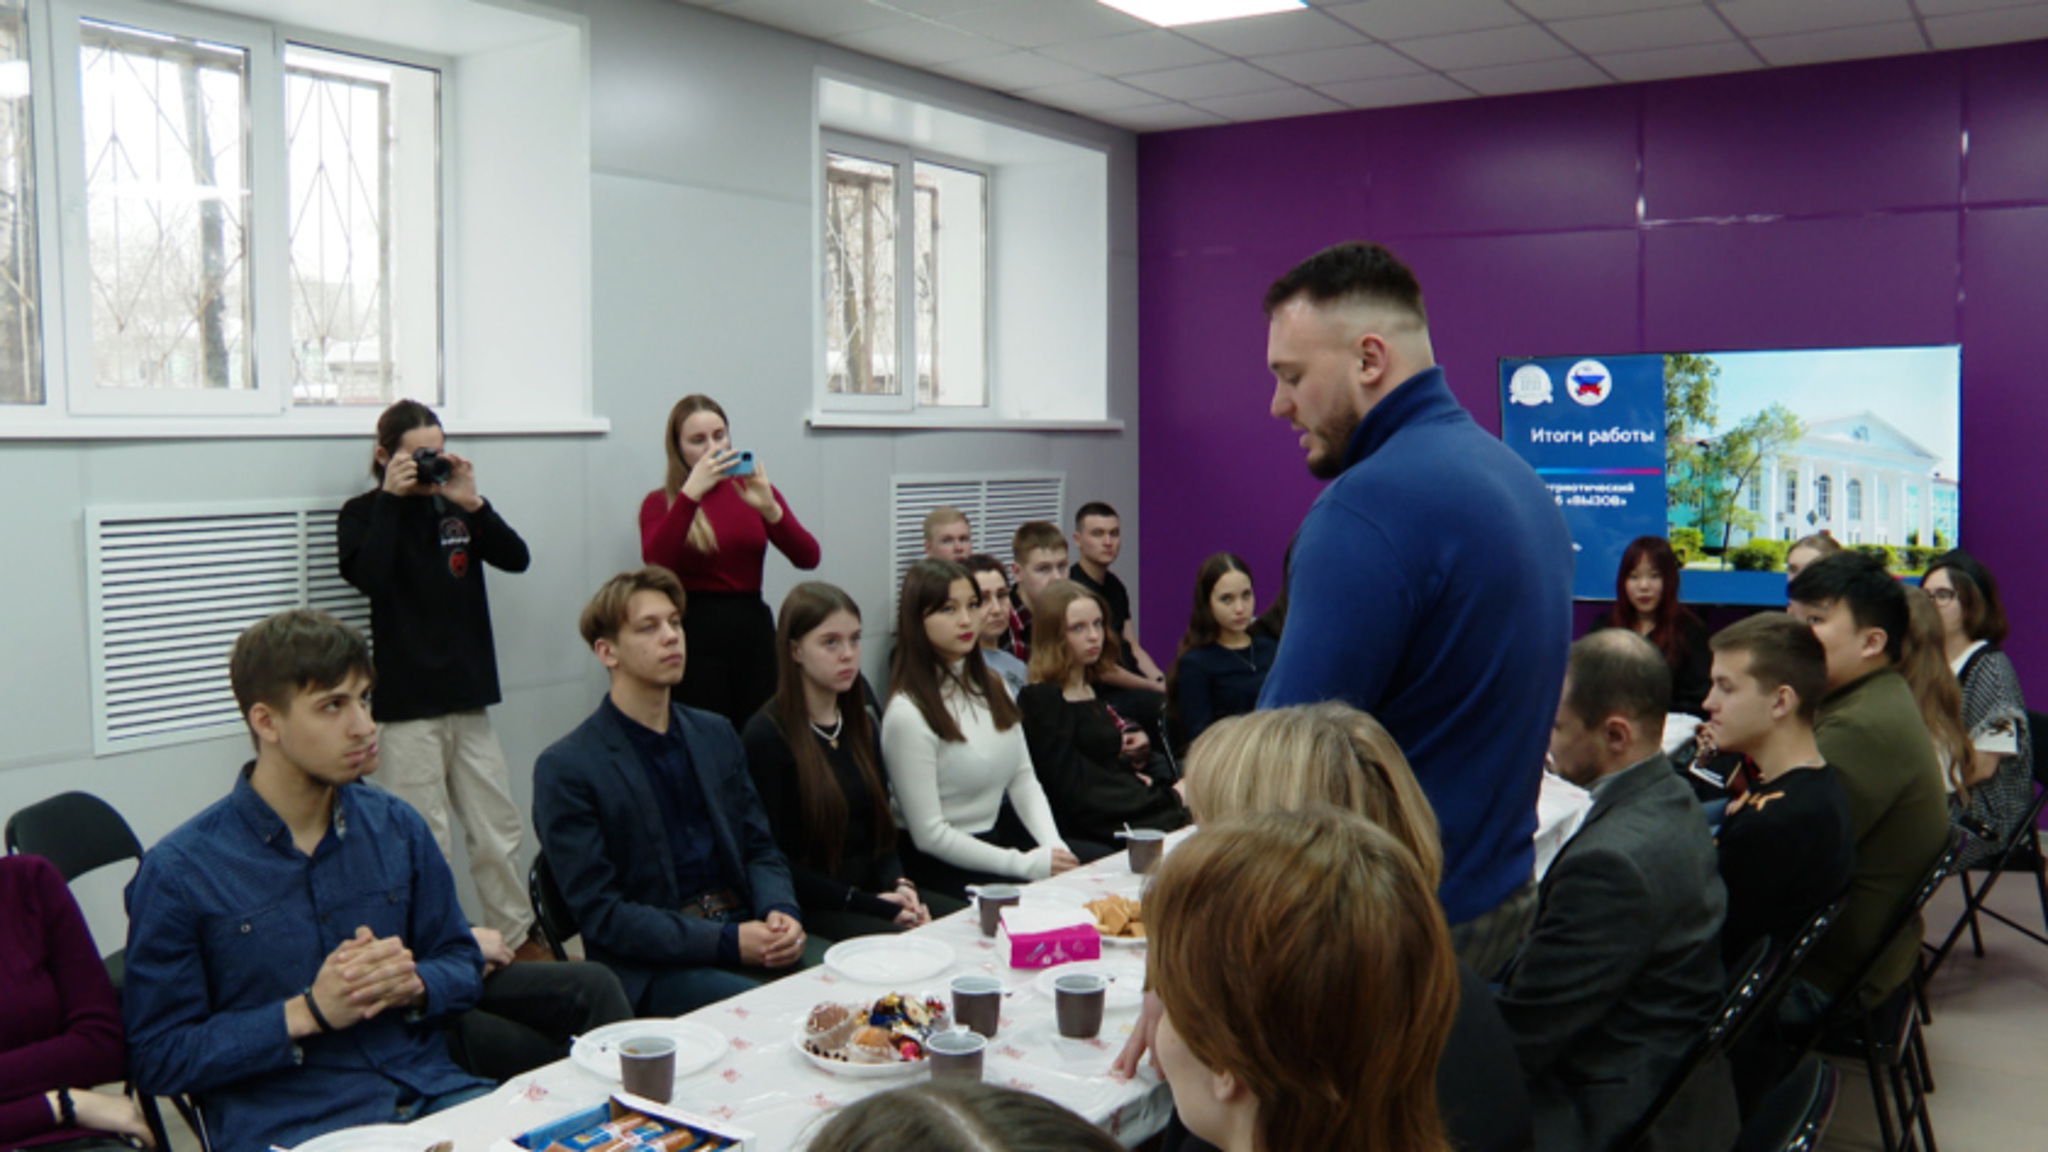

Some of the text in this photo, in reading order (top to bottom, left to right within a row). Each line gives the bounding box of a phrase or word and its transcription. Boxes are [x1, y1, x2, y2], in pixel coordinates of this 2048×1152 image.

[1530, 426, 1655, 447] Итоги работы
[1545, 482, 1635, 494] триотический
